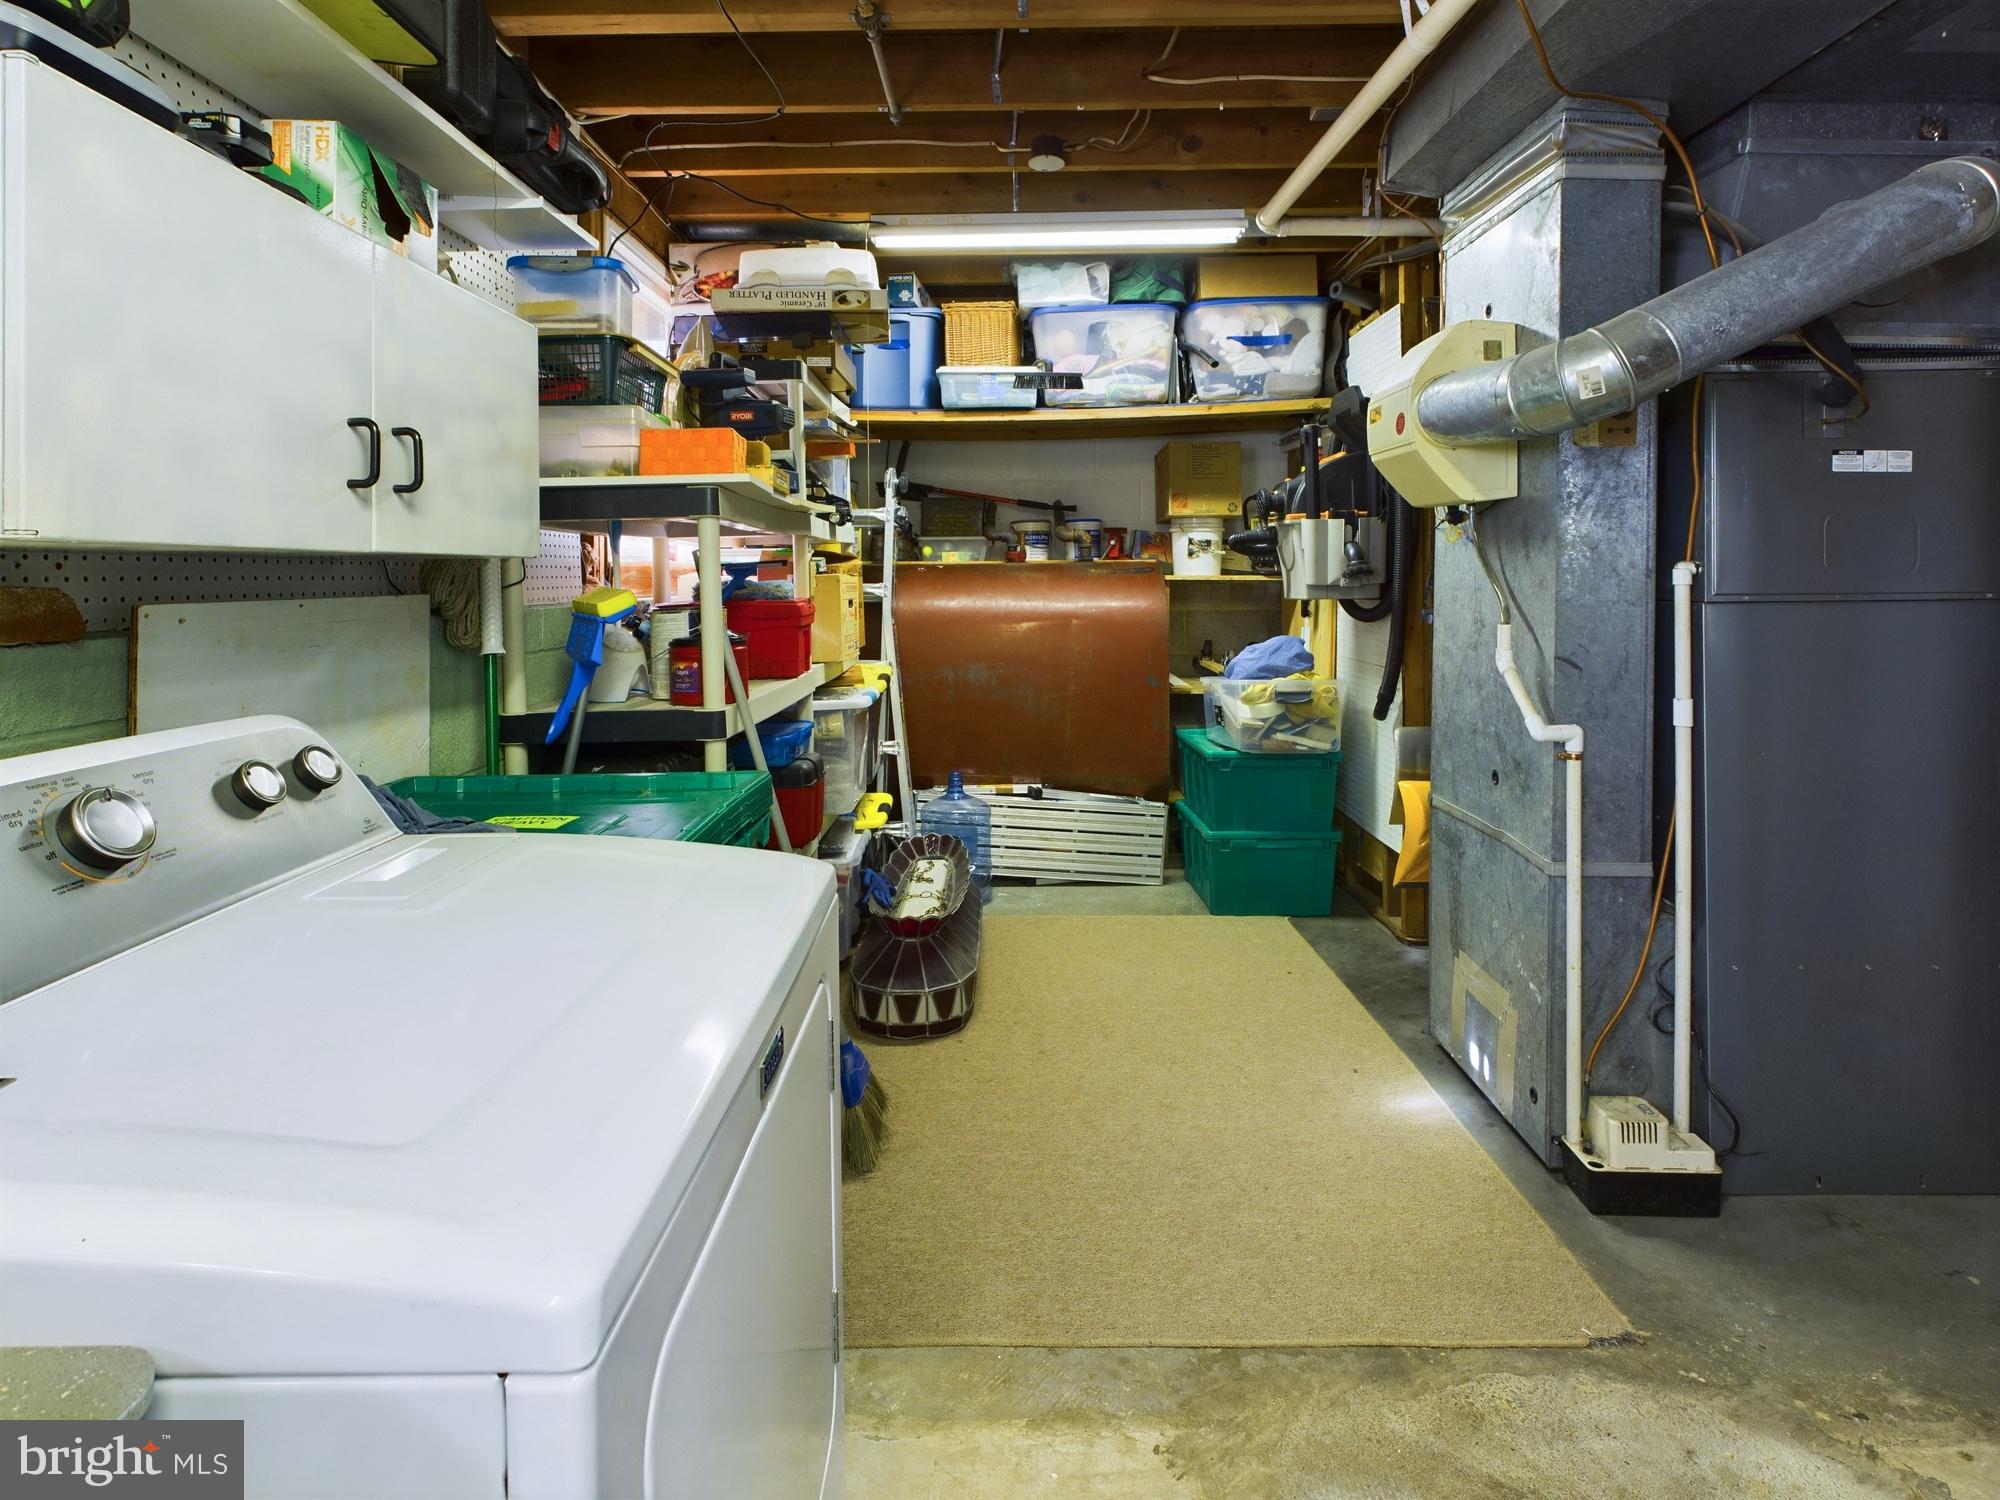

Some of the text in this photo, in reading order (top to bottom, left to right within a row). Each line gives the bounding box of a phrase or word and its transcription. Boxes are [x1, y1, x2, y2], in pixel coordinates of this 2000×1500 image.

[315, 126, 330, 161] HDX
[361, 185, 370, 233] avy-Duty
[729, 290, 826, 301] HANDLED PLATTER
[779, 301, 813, 309] Ceramic
[730, 412, 753, 420] RYOBI
[8, 818, 23, 828] dry
[18, 841, 44, 852] sanitize
[45, 850, 58, 861] off
